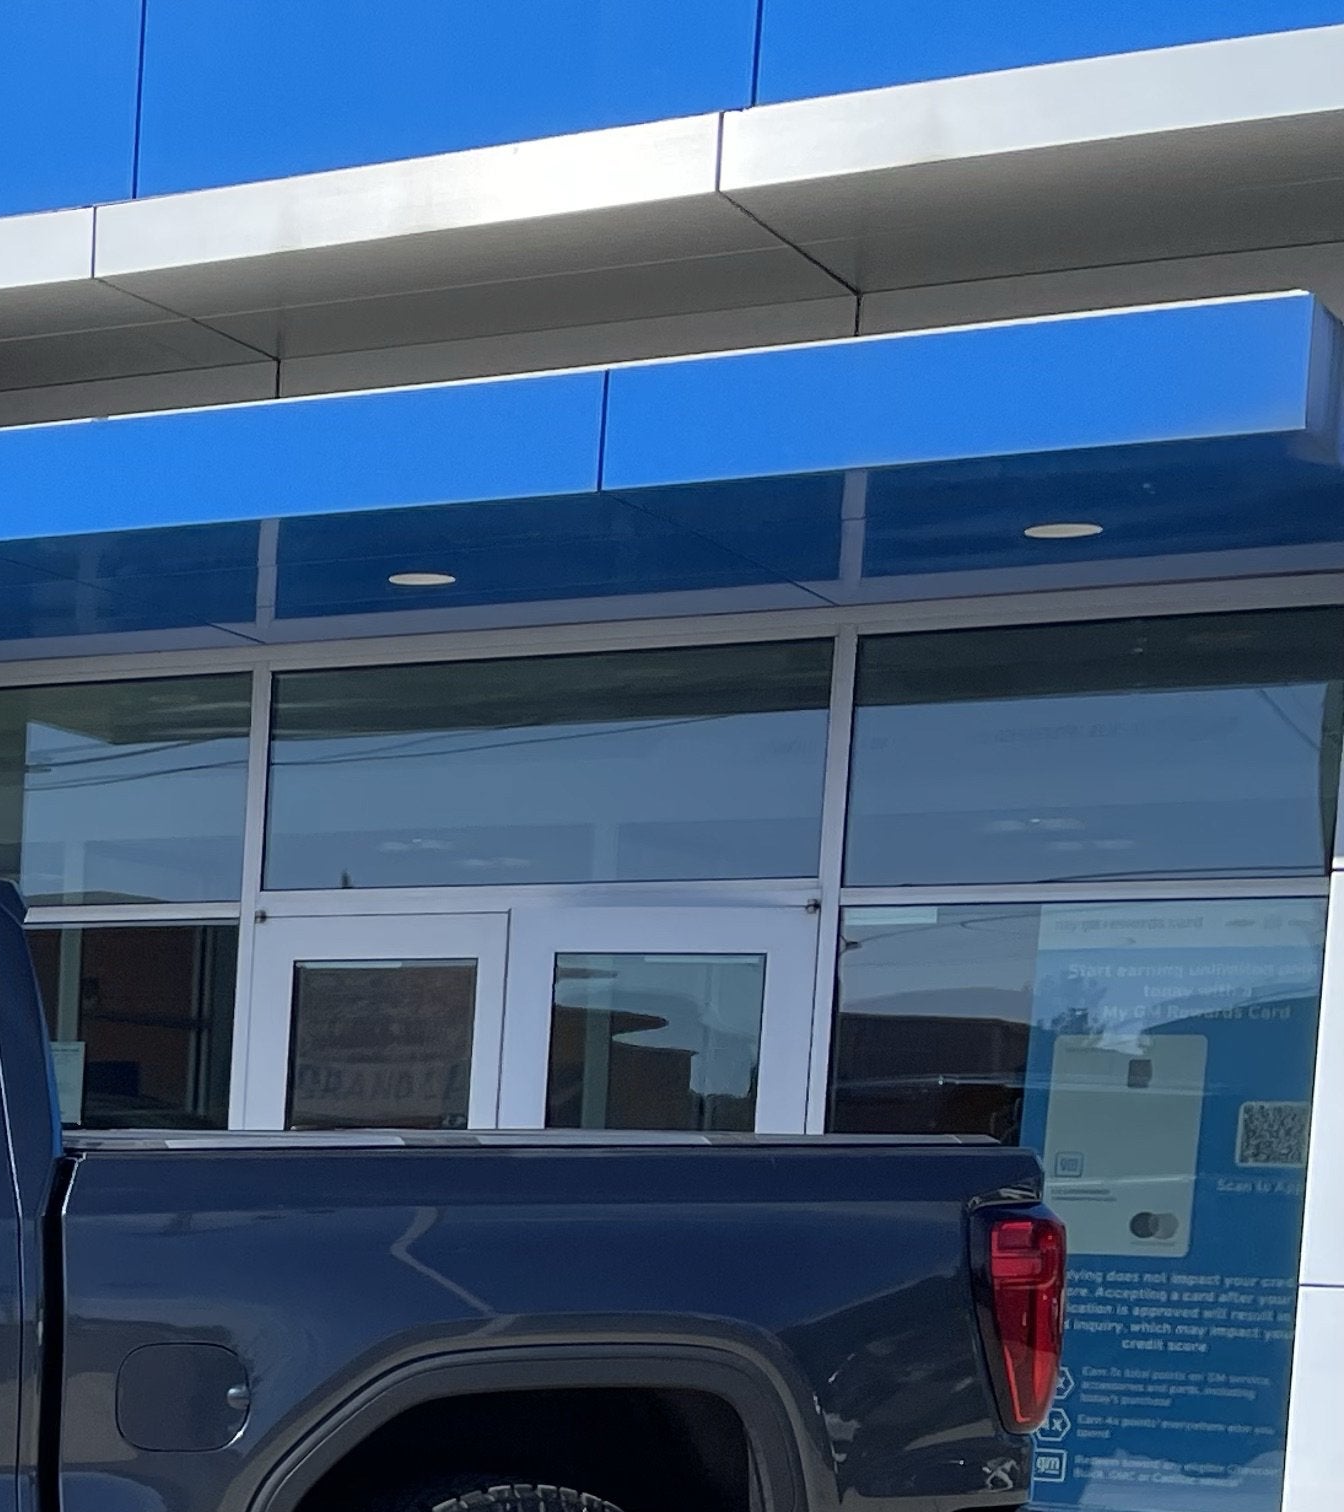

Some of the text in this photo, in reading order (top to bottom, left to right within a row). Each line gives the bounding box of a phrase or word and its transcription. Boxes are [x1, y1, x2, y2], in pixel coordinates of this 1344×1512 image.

[1068, 963, 1112, 980] Start
[1116, 964, 1184, 980] earning
[1103, 1004, 1292, 1020] My GM Rewards Card
[1216, 1178, 1252, 1193] Scan
